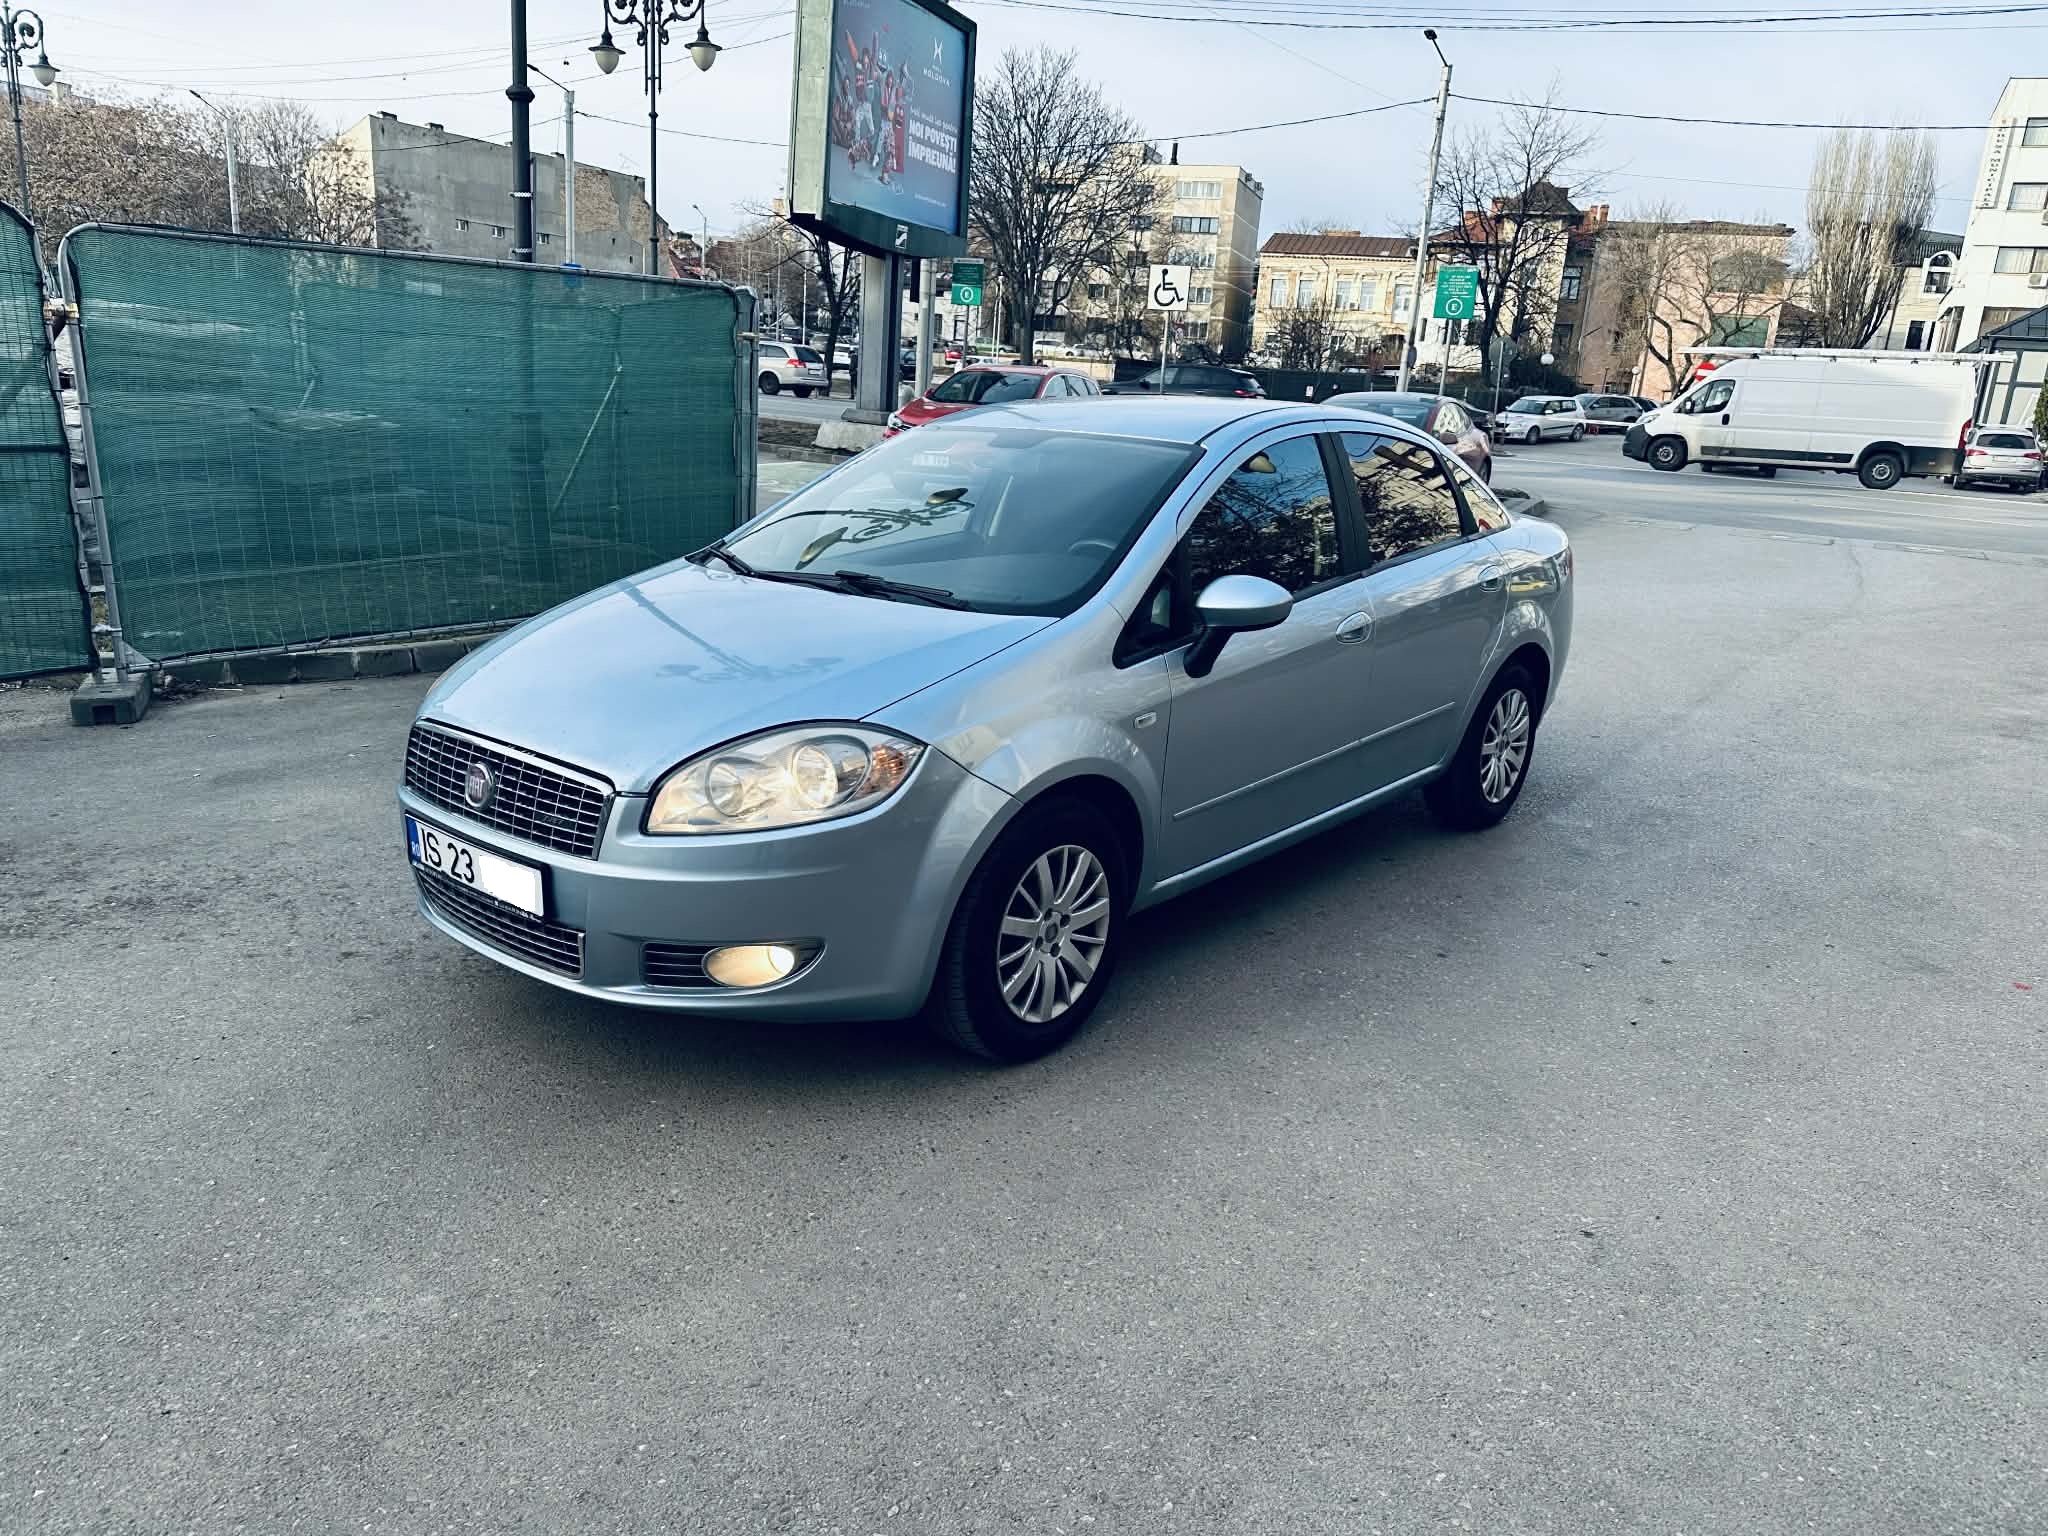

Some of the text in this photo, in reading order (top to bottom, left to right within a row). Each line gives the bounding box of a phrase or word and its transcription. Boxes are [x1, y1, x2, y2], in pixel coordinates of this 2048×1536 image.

[909, 119, 924, 139] NOI
[411, 841, 421, 857] RO
[421, 827, 475, 884] IS 23
